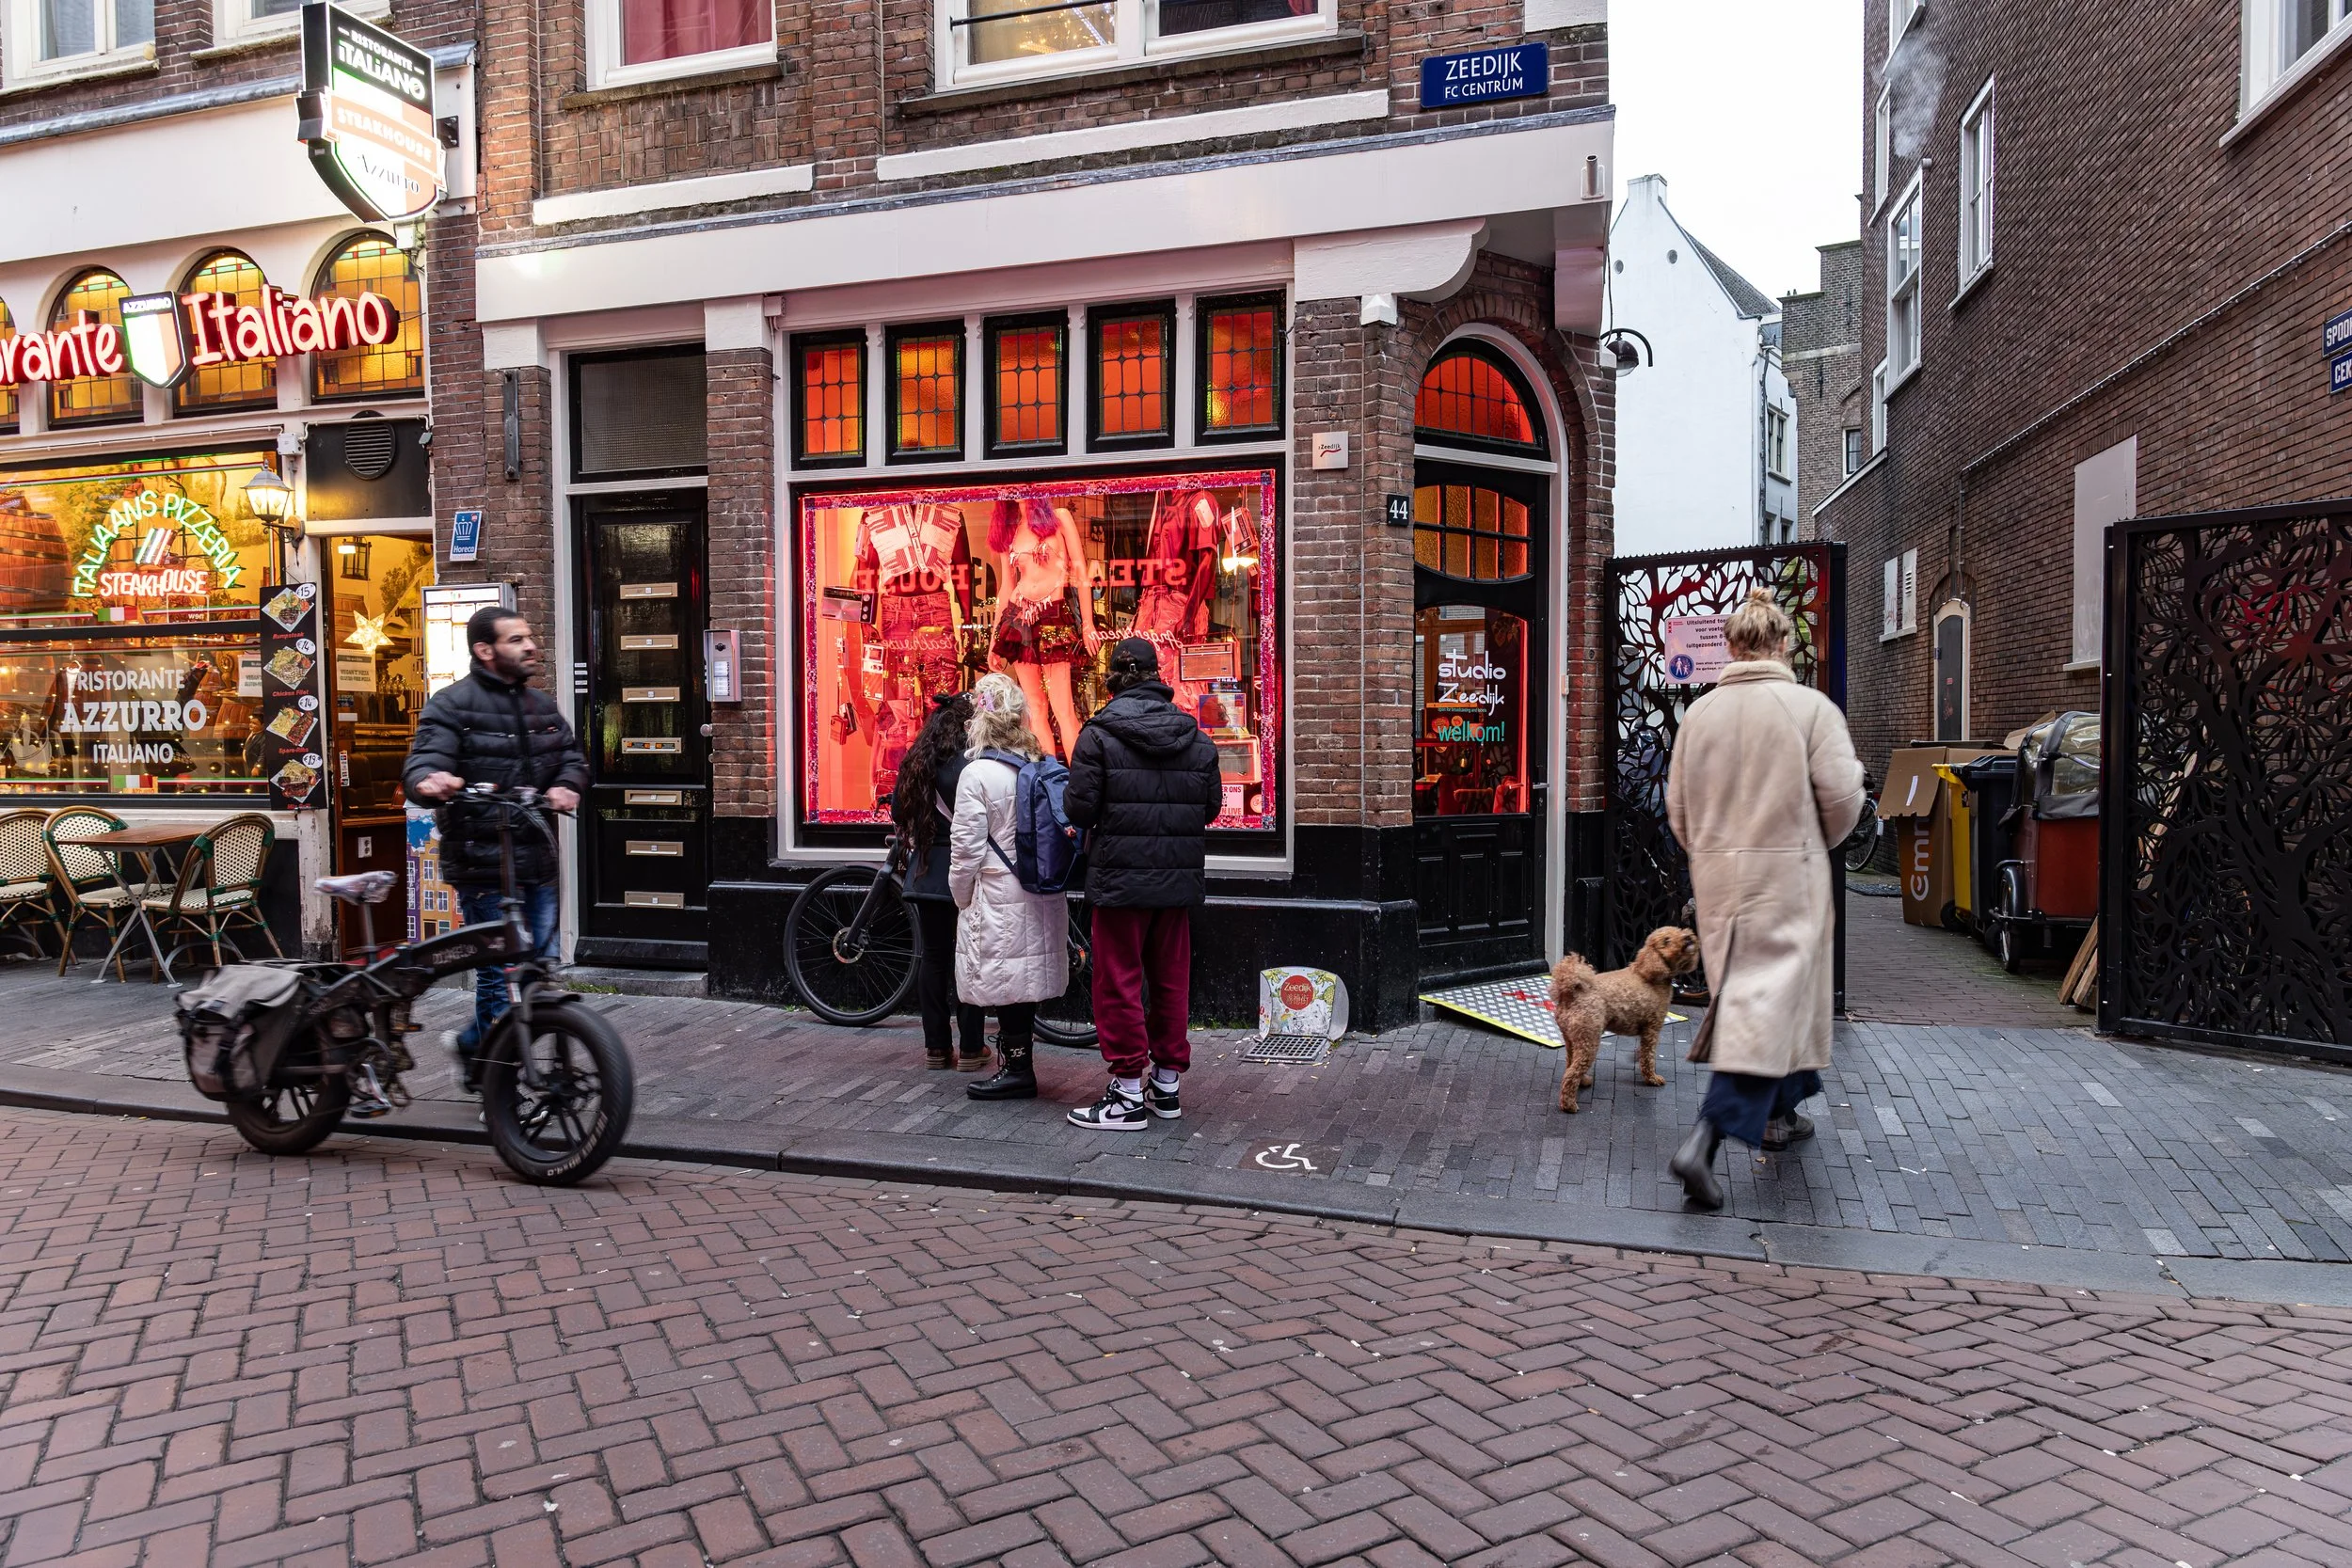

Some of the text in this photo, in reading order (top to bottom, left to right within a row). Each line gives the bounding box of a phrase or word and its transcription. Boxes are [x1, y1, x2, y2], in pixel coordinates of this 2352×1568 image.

[351, 30, 413, 71] RISTORANTE
[1445, 52, 1522, 81] ZEEDIJK
[1444, 77, 1523, 99] FC CENTRUM
[337, 107, 433, 163] STEAKHOUSE
[0, 284, 389, 383] rante Italiano
[2326, 316, 2352, 347] SPOO
[1389, 499, 1408, 520] 44
[73, 490, 243, 597] ITALIAANS PIZZERIA
[100, 569, 209, 597] STEAKHOUSE
[1438, 648, 1507, 679] studio
[77, 669, 185, 691] RISTORANTE
[1438, 682, 1505, 716] Zeedijk
[60, 699, 208, 732] AZZURRO
[1438, 721, 1505, 742] welkom!
[93, 742, 175, 764] ITALIANO
[1284, 982, 1311, 993] Zeedijk
